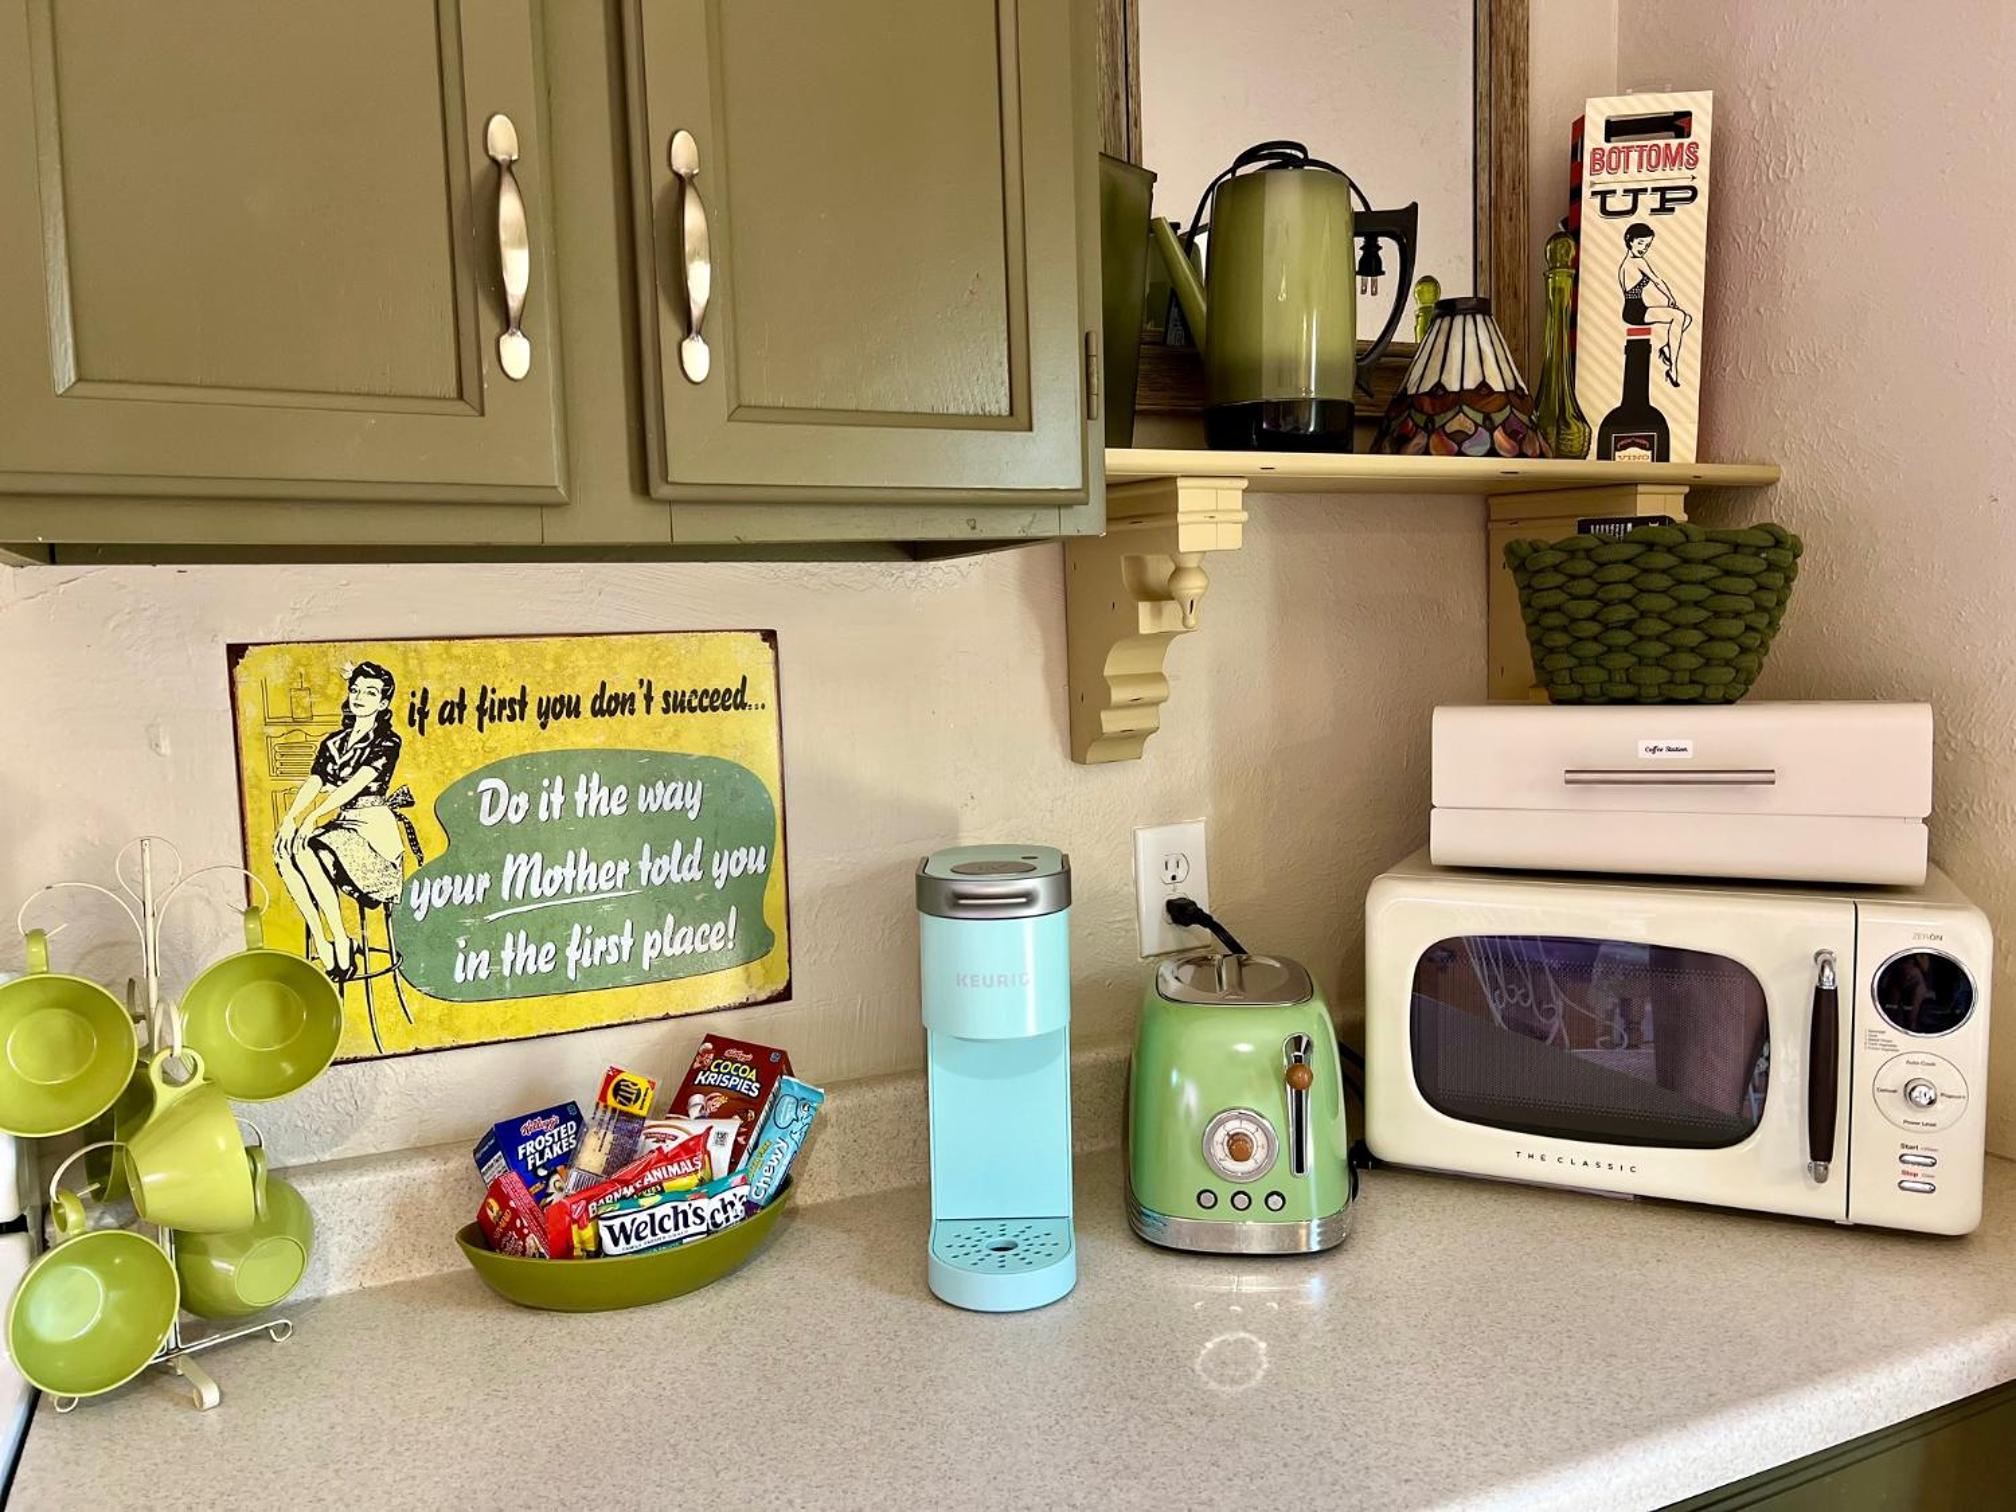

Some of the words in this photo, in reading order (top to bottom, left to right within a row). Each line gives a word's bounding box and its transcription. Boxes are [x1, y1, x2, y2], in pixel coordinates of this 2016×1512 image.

[1590, 141, 1700, 176] BOTTOMS
[1588, 185, 1698, 219] UP
[407, 686, 430, 737] if
[437, 686, 467, 725] at
[475, 684, 529, 734] first
[536, 693, 582, 730] you
[590, 678, 654, 718] don't
[661, 674, 766, 715] succeed...
[476, 776, 530, 827] Do
[538, 774, 566, 822] it
[574, 770, 629, 818] the
[637, 778, 703, 822] way
[409, 872, 491, 922] your
[501, 847, 630, 901] Mother
[638, 836, 704, 886] told
[711, 844, 767, 890] you
[454, 937, 492, 983] in
[500, 928, 557, 977] the
[565, 918, 634, 981] first
[642, 904, 738, 972] place!
[956, 972, 1031, 988] KEURIG
[694, 1071, 761, 1098] KRISPIES
[710, 1060, 757, 1082] COCOA
[517, 1121, 578, 1161] FROSTED
[527, 1135, 577, 1171] FLAKES
[643, 1157, 702, 1186] ANIMALS
[751, 1137, 789, 1200] Chewy
[1515, 1151, 1547, 1162] THE
[1557, 1156, 1637, 1173] CLASSIC
[604, 1203, 706, 1248] Welch's
